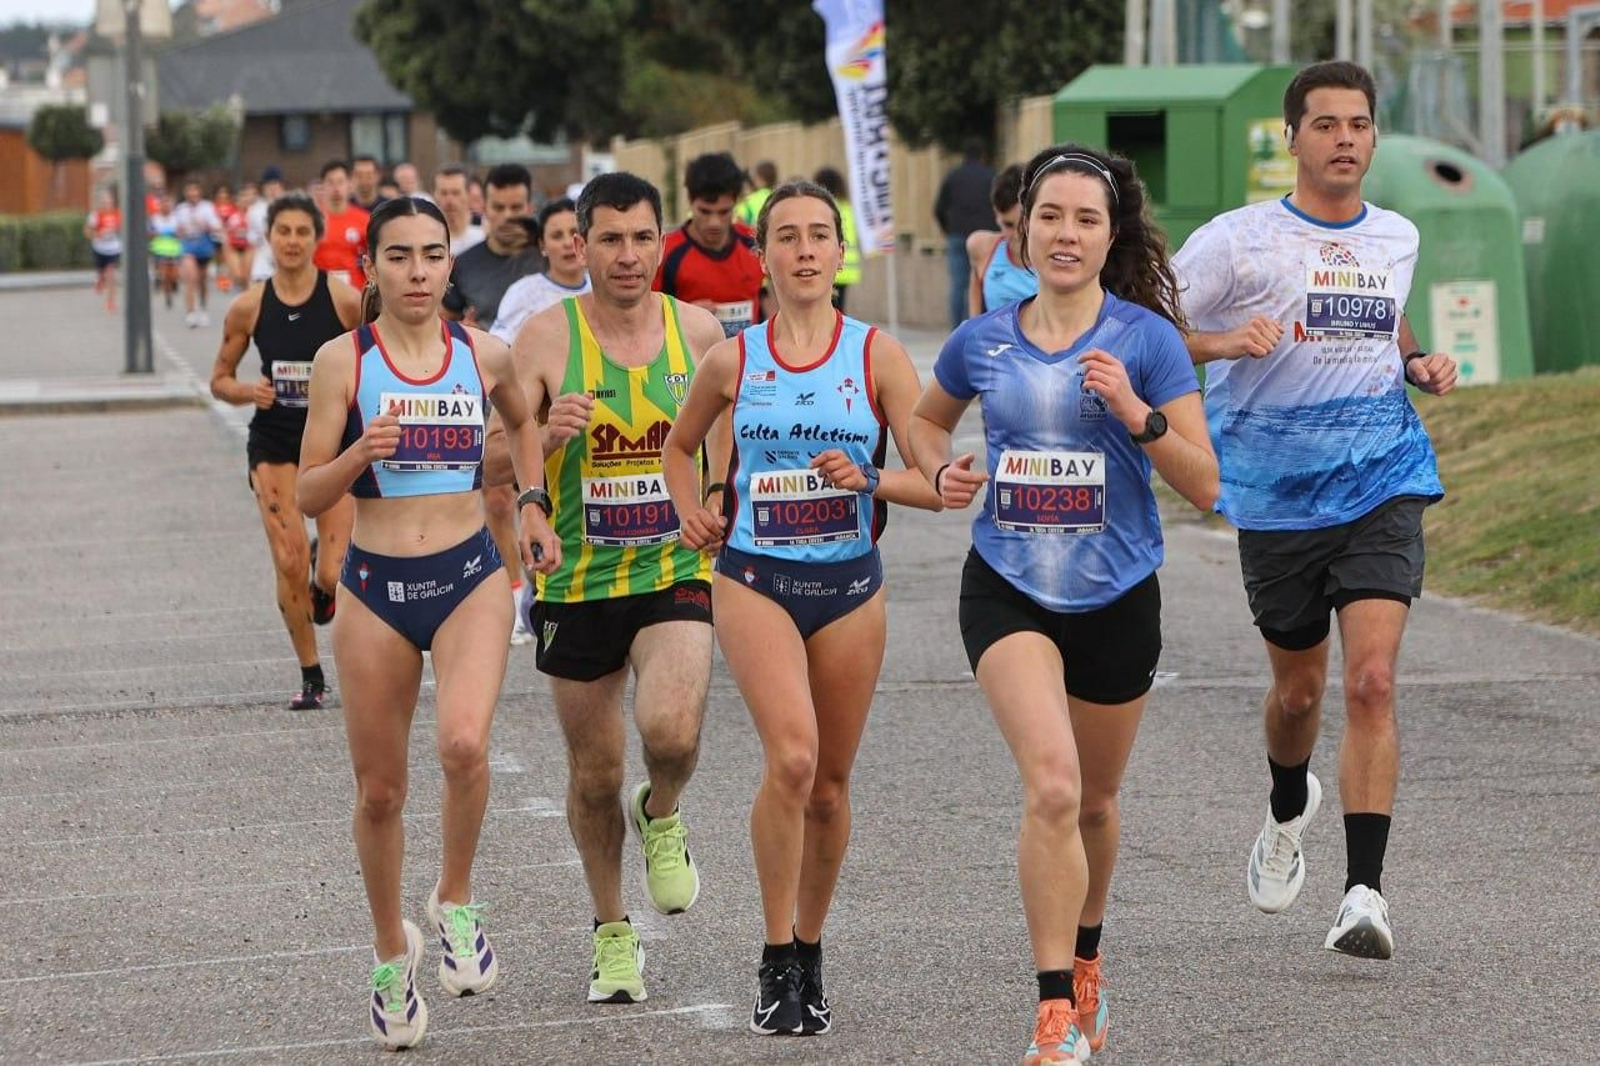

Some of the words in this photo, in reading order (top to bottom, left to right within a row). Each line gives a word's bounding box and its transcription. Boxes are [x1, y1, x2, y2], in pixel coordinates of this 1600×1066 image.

[1314, 271, 1387, 290] MINIBAY
[1325, 296, 1387, 320] 10978
[402, 427, 472, 449] 10193
[741, 423, 779, 441] Celta
[626, 460, 654, 468] Projetos
[1005, 457, 1095, 477] MINIBAY
[1014, 486, 1090, 511] 10238
[603, 502, 671, 527] 10191
[772, 499, 845, 525] 10203
[406, 580, 437, 591] XUNTA
[407, 591, 418, 600] DE
[420, 583, 455, 599] GALICIA
[793, 580, 822, 588] XUNTA
[804, 588, 838, 596] GALICIA
